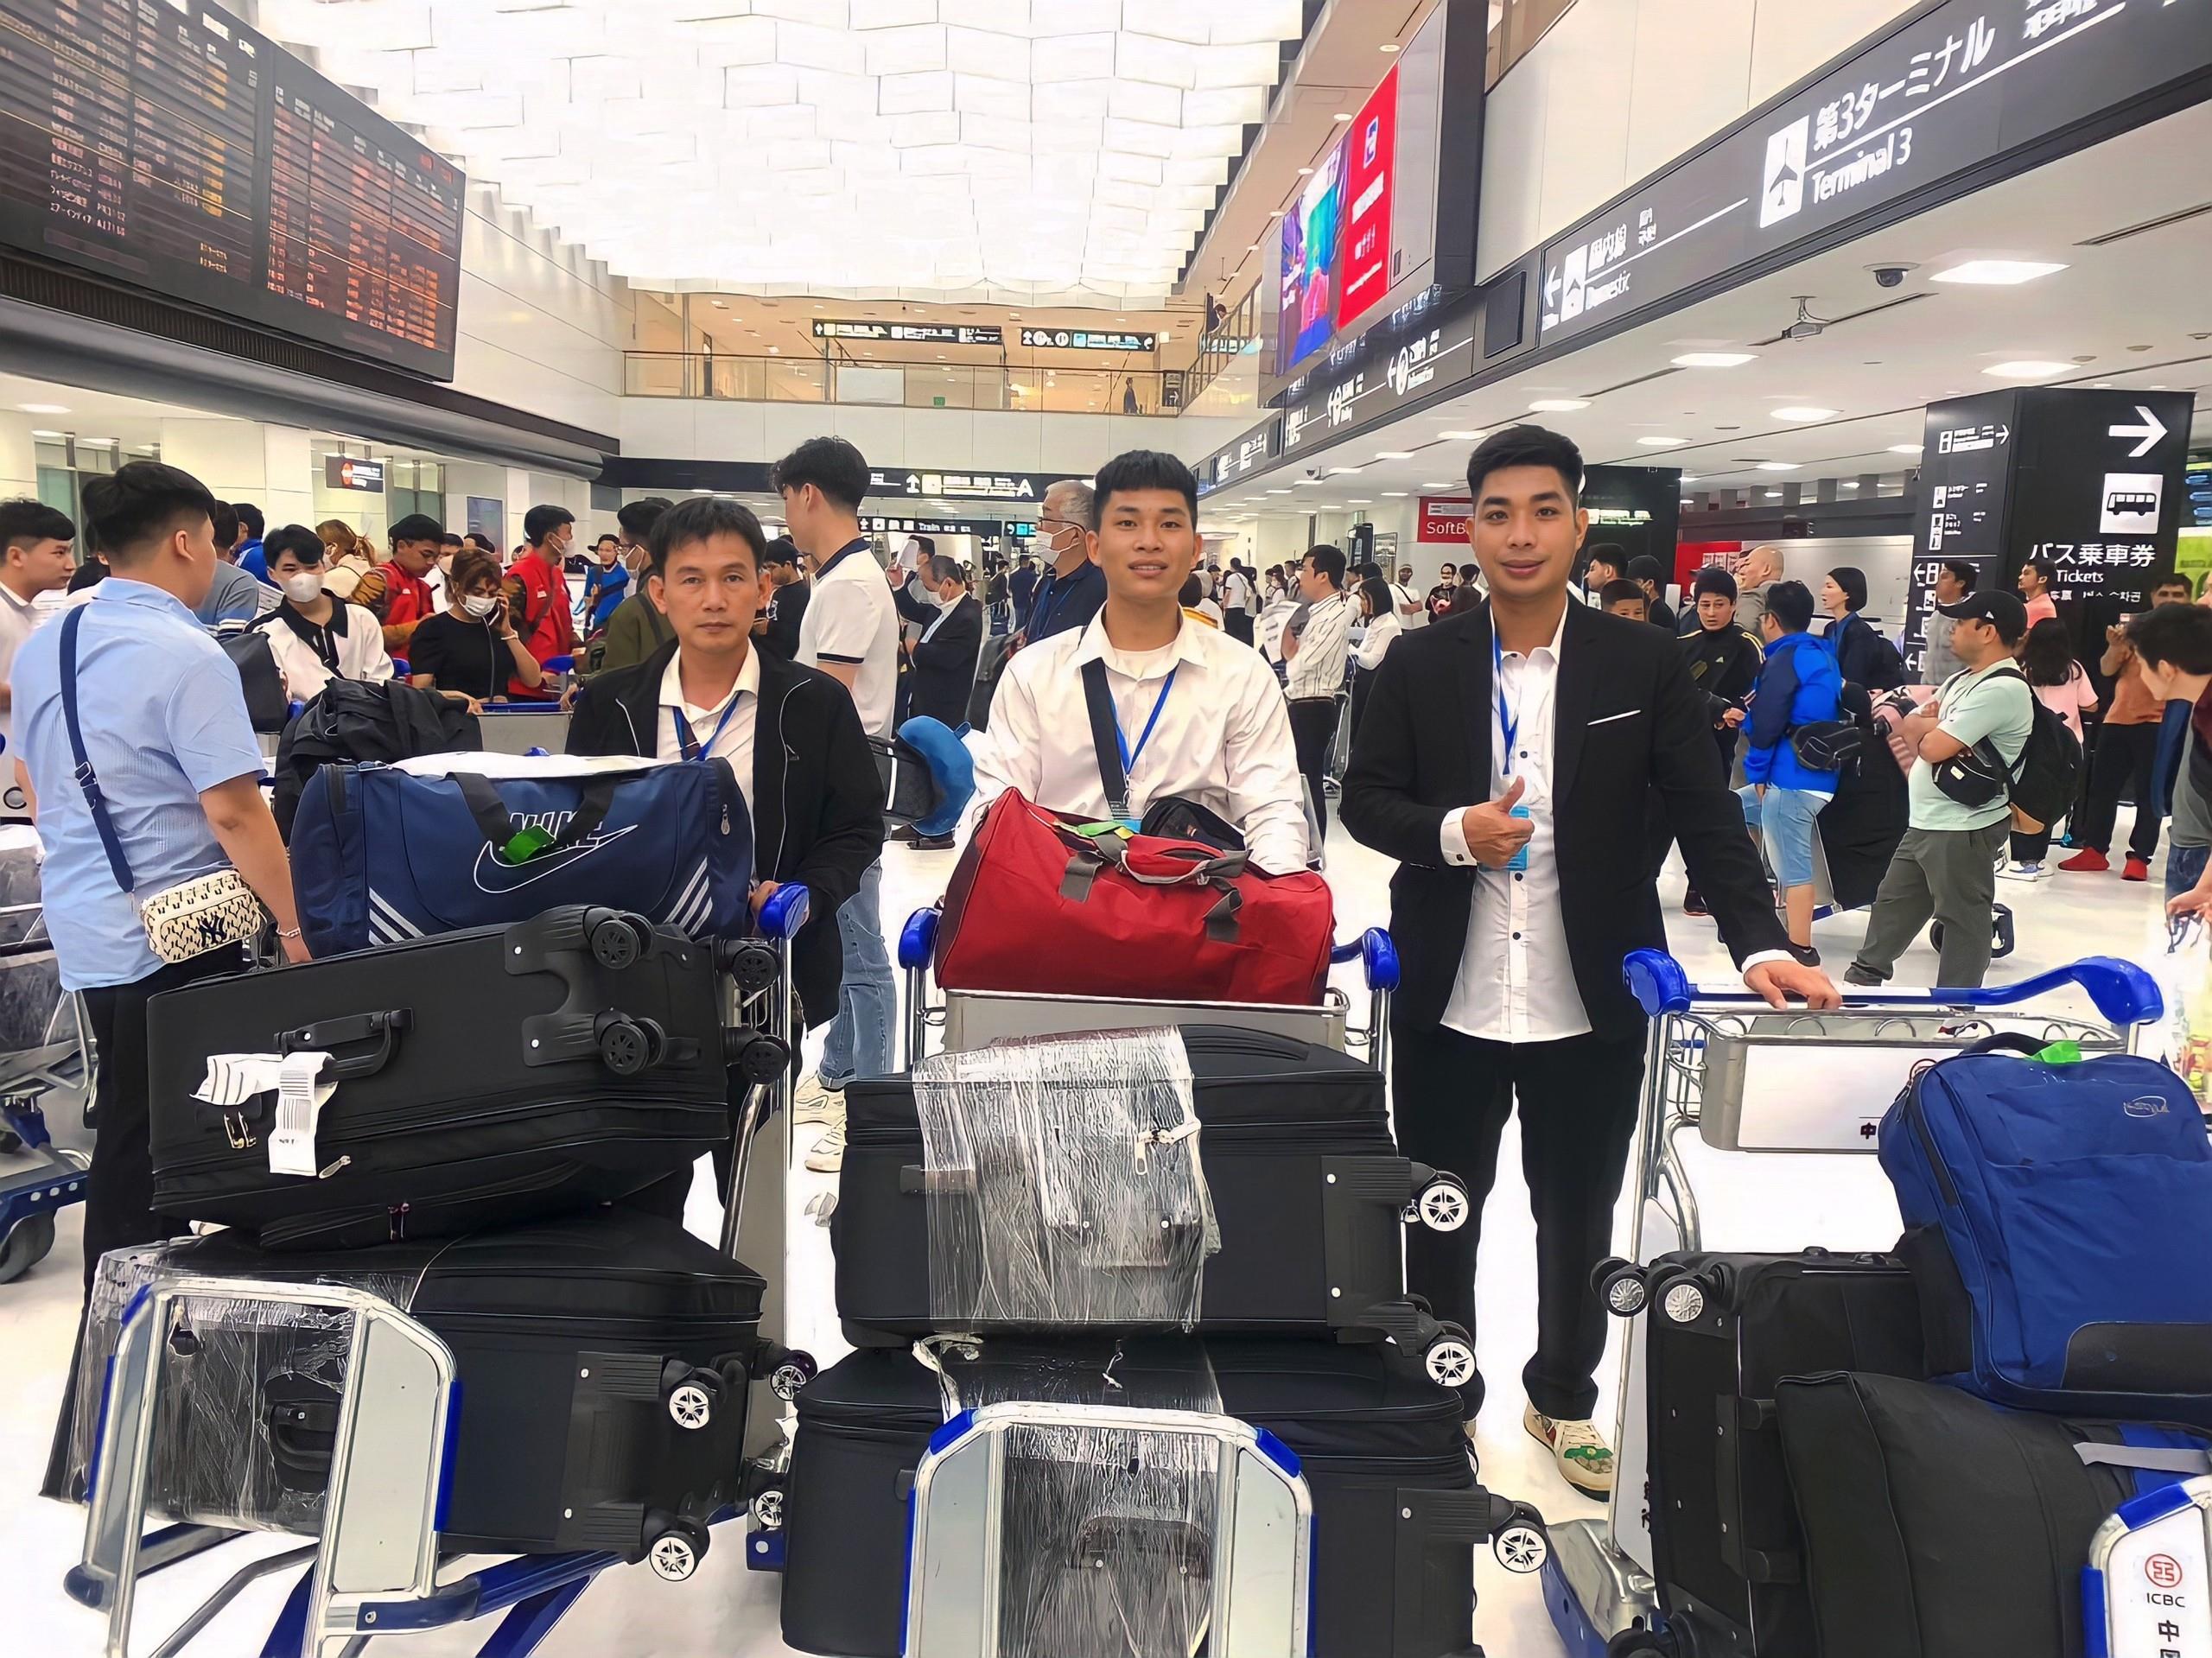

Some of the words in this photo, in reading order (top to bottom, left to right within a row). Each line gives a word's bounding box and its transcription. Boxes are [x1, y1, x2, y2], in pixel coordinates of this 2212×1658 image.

[1815, 16, 1996, 151] 第3ターミナル
[1812, 133, 1894, 205] Terminal
[1896, 127, 1913, 165] 3
[2029, 543, 2157, 568] バス乗車券
[2056, 569, 2105, 583] Tickets
[2146, 1592, 2185, 1608] ICBC
